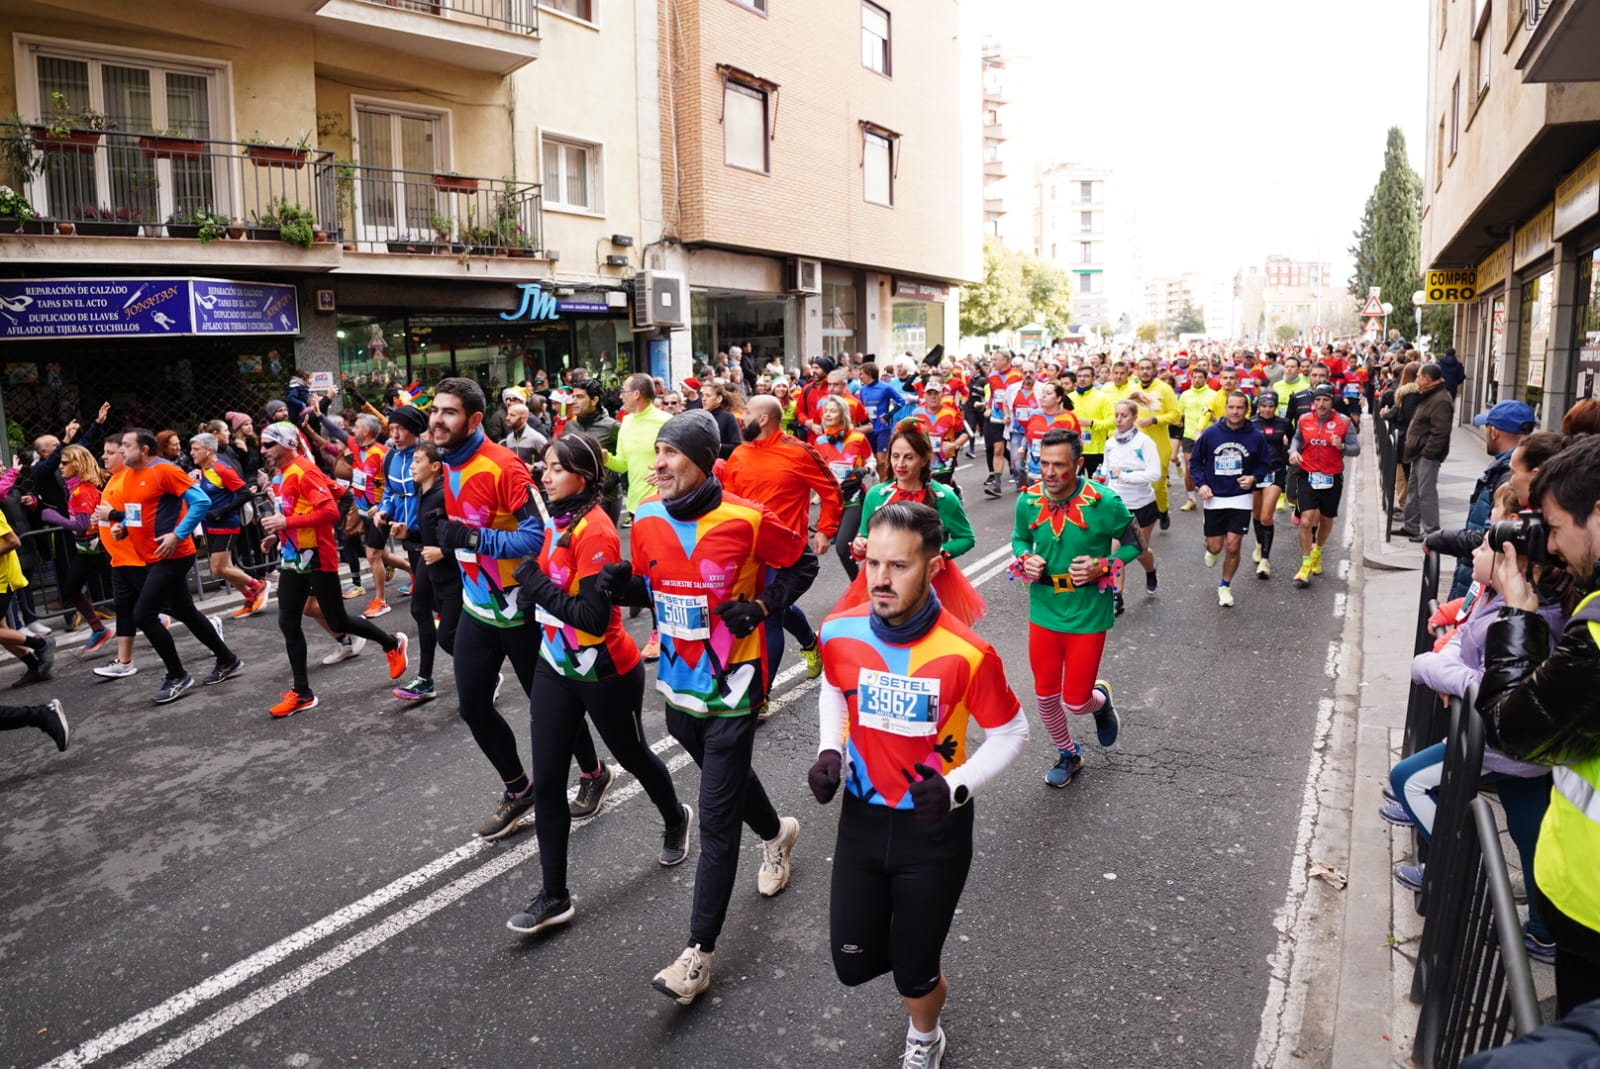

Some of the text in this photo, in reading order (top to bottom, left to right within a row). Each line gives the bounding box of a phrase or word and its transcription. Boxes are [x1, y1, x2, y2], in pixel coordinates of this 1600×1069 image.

[1430, 273, 1475, 286] COMPRO
[25, 285, 128, 295] REPARACIÓN DE CALZADO
[1430, 288, 1474, 300] ORO
[37, 299, 107, 308] TAPAS EN EL ACTO
[29, 312, 119, 322] DUPLICADO DE LLAVES
[7, 323, 140, 335] AFILADO DE TIJERAS Y CUCHILLOS
[665, 596, 701, 606] SETEL
[664, 604, 688, 625] 5011
[880, 676, 931, 692] SETEL
[868, 686, 918, 718] 3962
